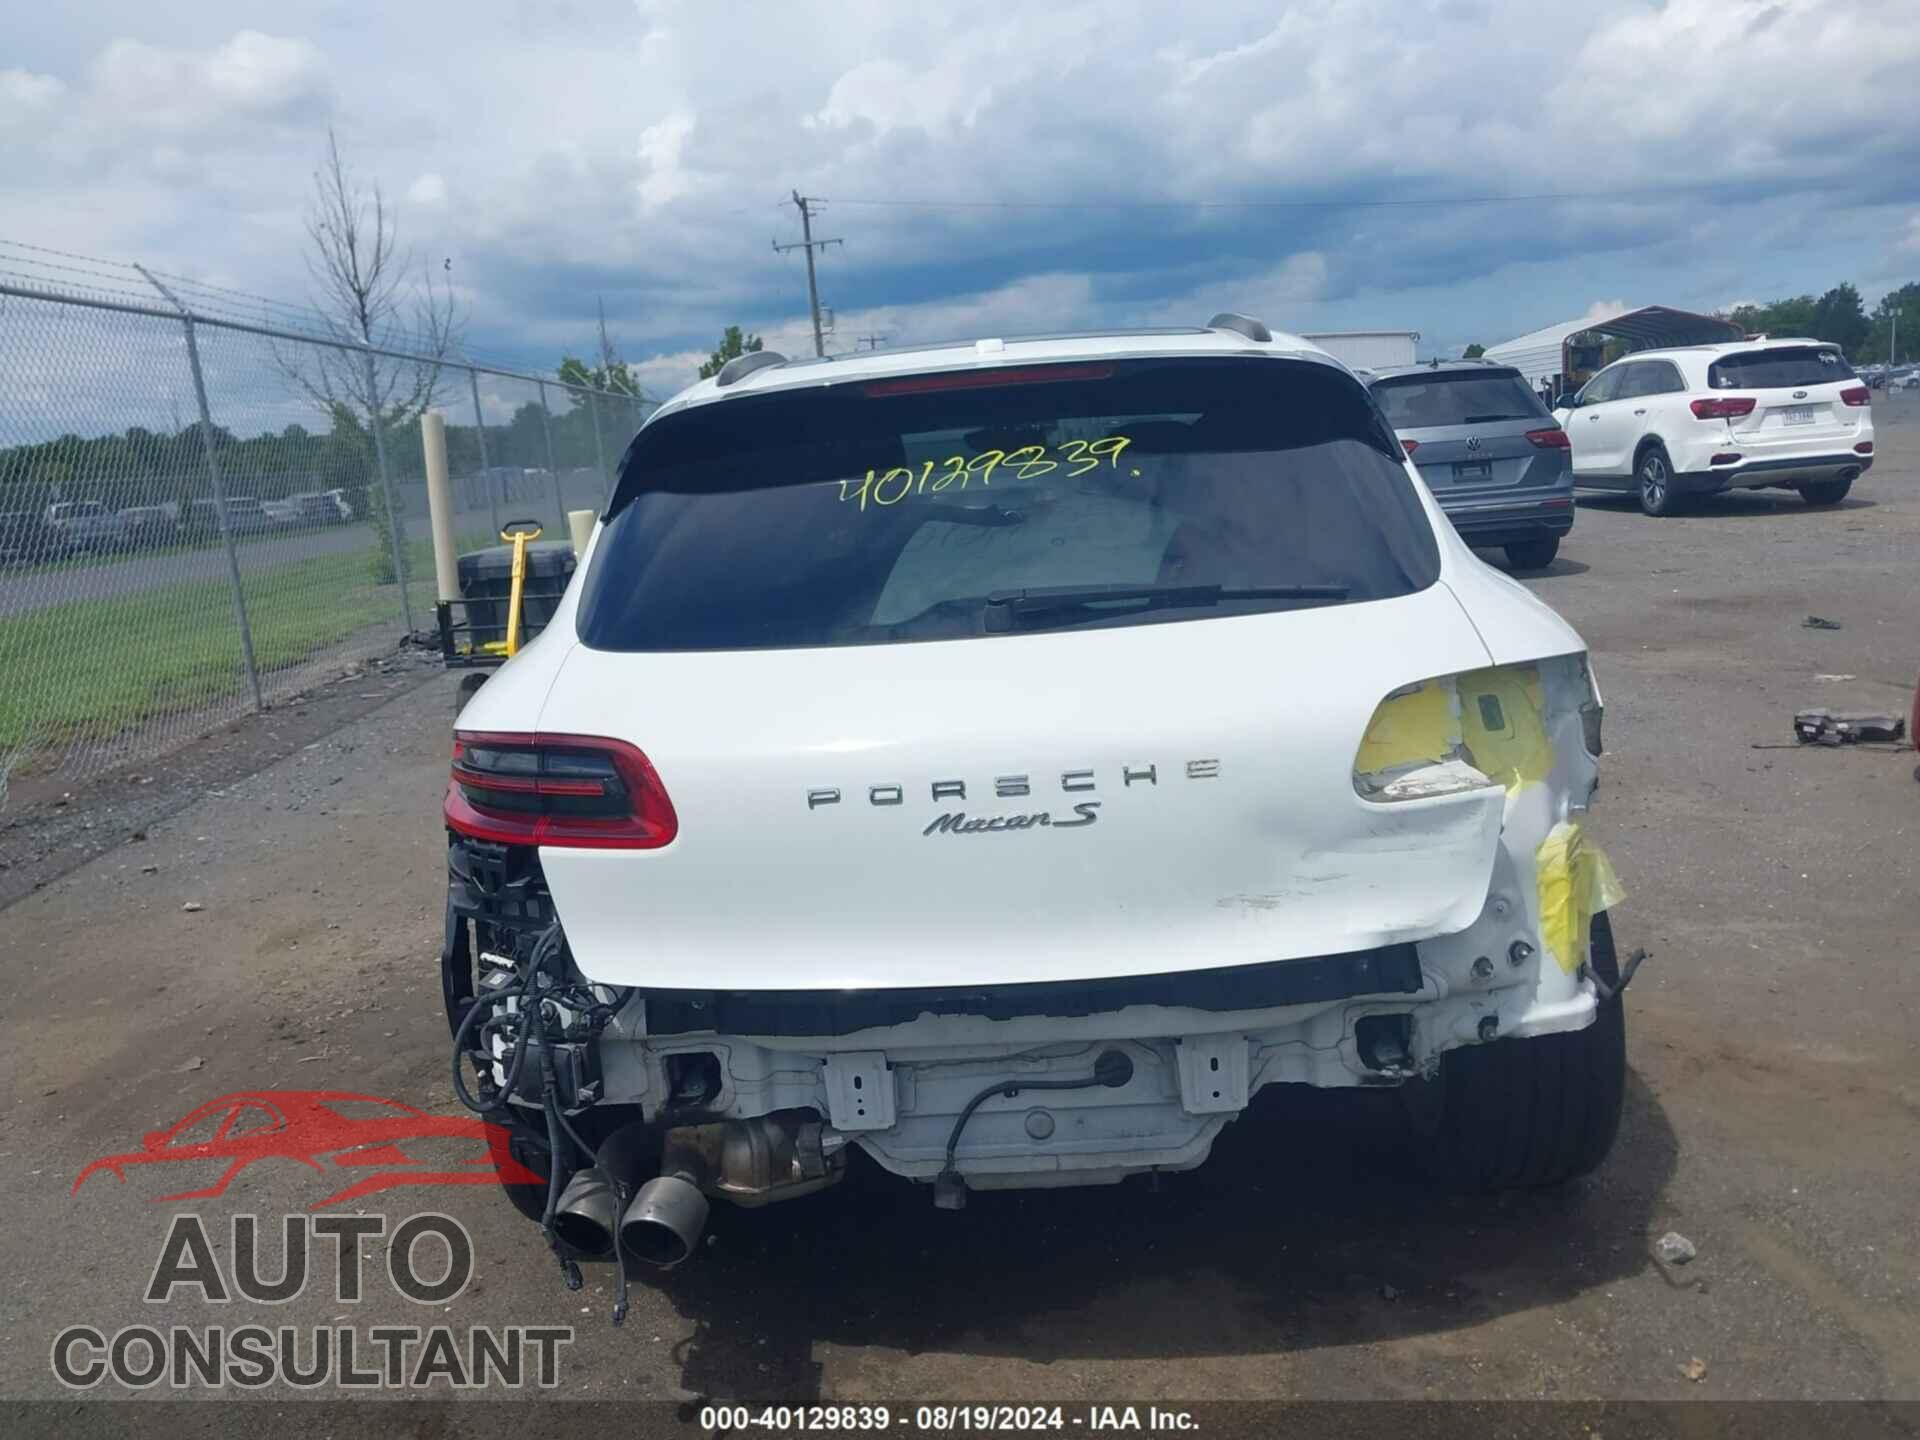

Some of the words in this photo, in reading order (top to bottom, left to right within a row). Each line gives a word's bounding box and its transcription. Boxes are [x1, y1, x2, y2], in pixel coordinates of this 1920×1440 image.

[808, 758, 1219, 809] PORSCHE
[922, 811, 1051, 836] Macan
[1052, 801, 1101, 828] S
